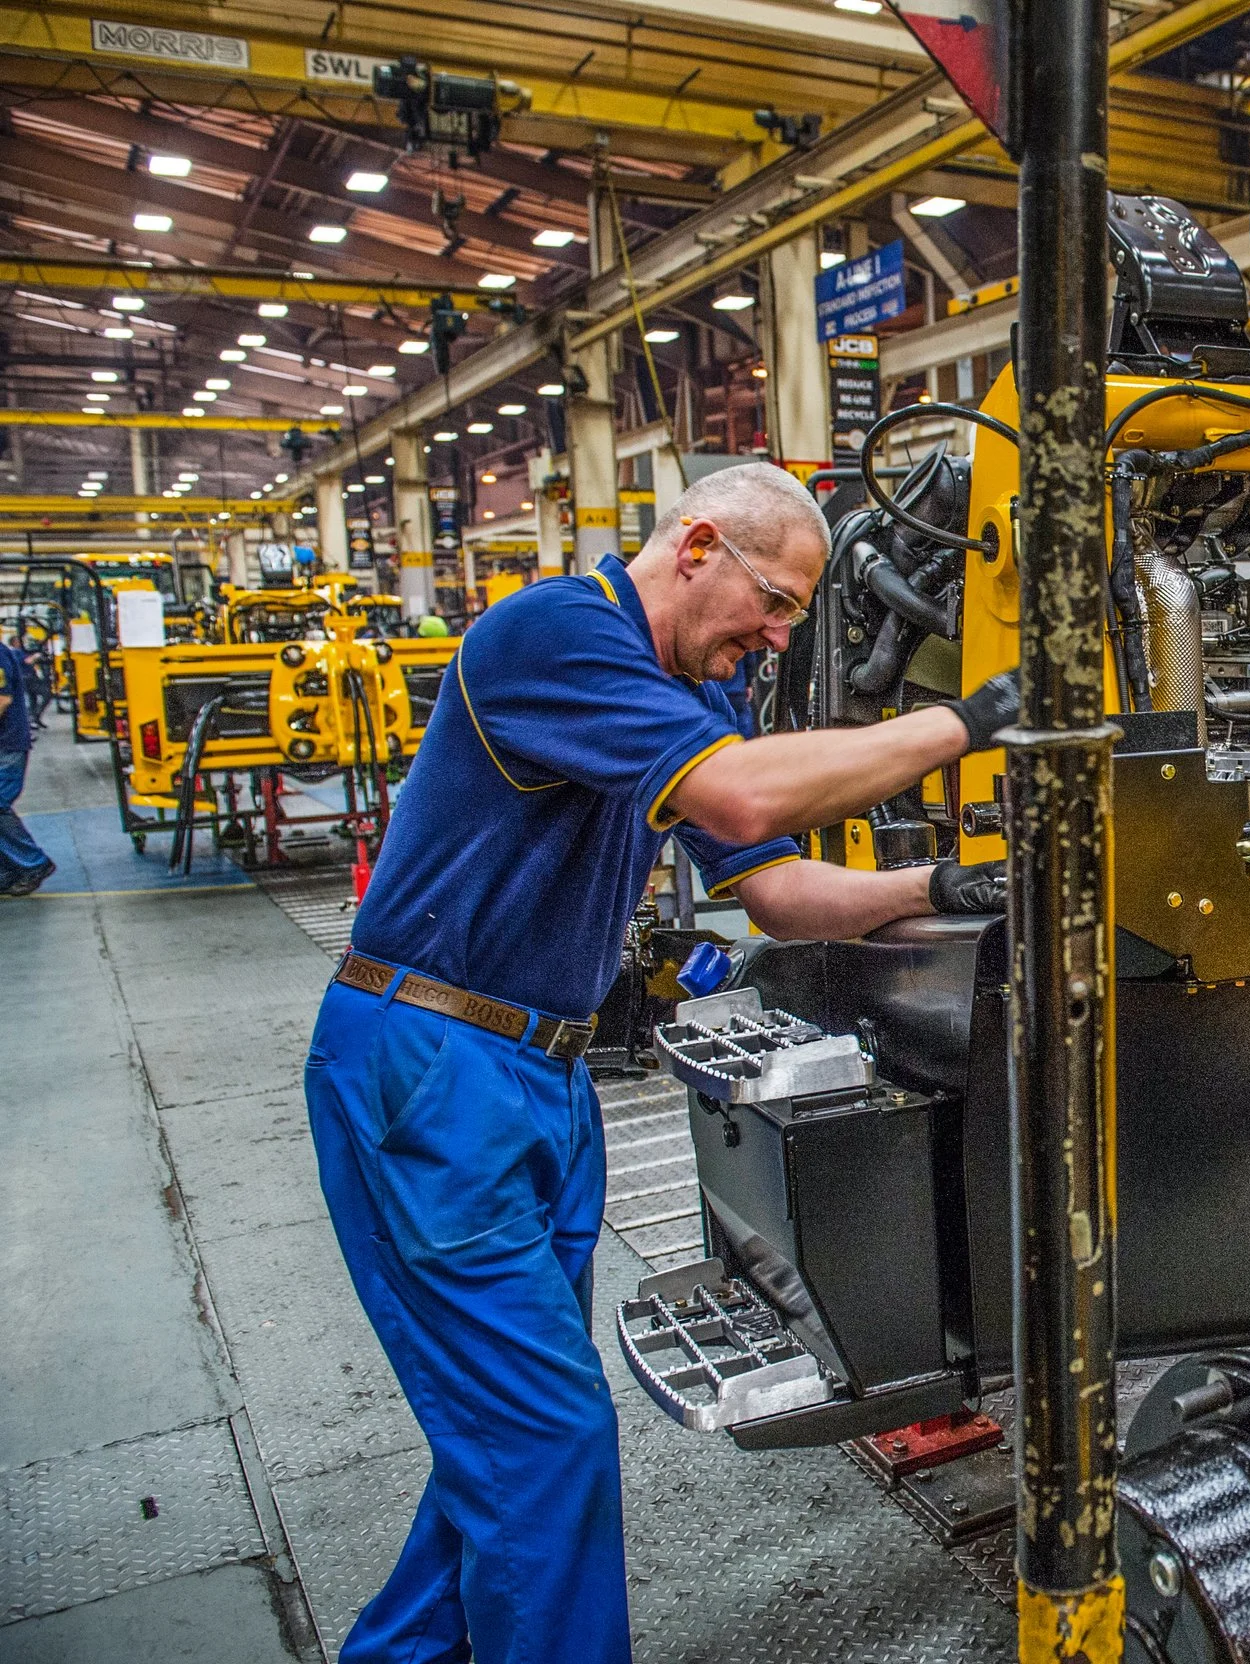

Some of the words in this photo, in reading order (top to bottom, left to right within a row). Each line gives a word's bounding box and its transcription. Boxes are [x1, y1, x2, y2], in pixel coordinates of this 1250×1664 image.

[99, 23, 244, 61] MORRIS
[311, 54, 369, 80] SWL
[833, 338, 874, 355] JCB
[837, 379, 873, 391] REDUCE
[837, 409, 877, 421] RECYCLE
[345, 960, 388, 989] BOSS
[400, 979, 448, 1006] HUGO
[463, 996, 516, 1031] BOSS
